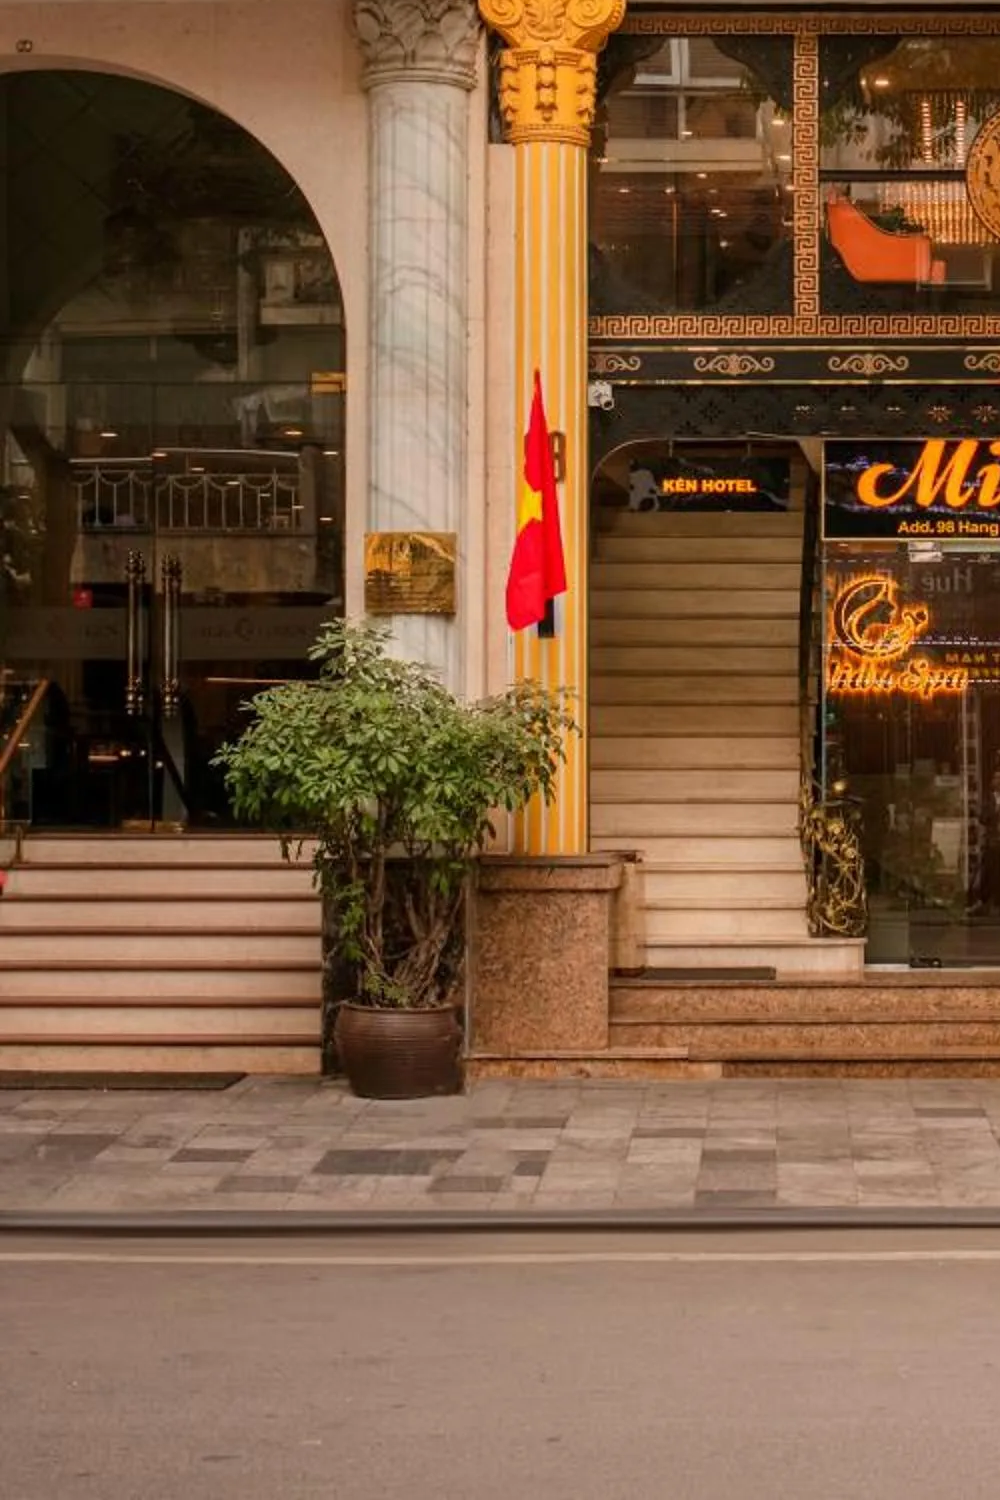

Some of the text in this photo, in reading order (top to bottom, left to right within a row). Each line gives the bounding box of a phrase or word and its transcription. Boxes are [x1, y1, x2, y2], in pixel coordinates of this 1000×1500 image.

[702, 479, 757, 492] HOTEL
[898, 521, 935, 533] Add.
[958, 521, 999, 536] Hang
[898, 659, 969, 699] Spa
